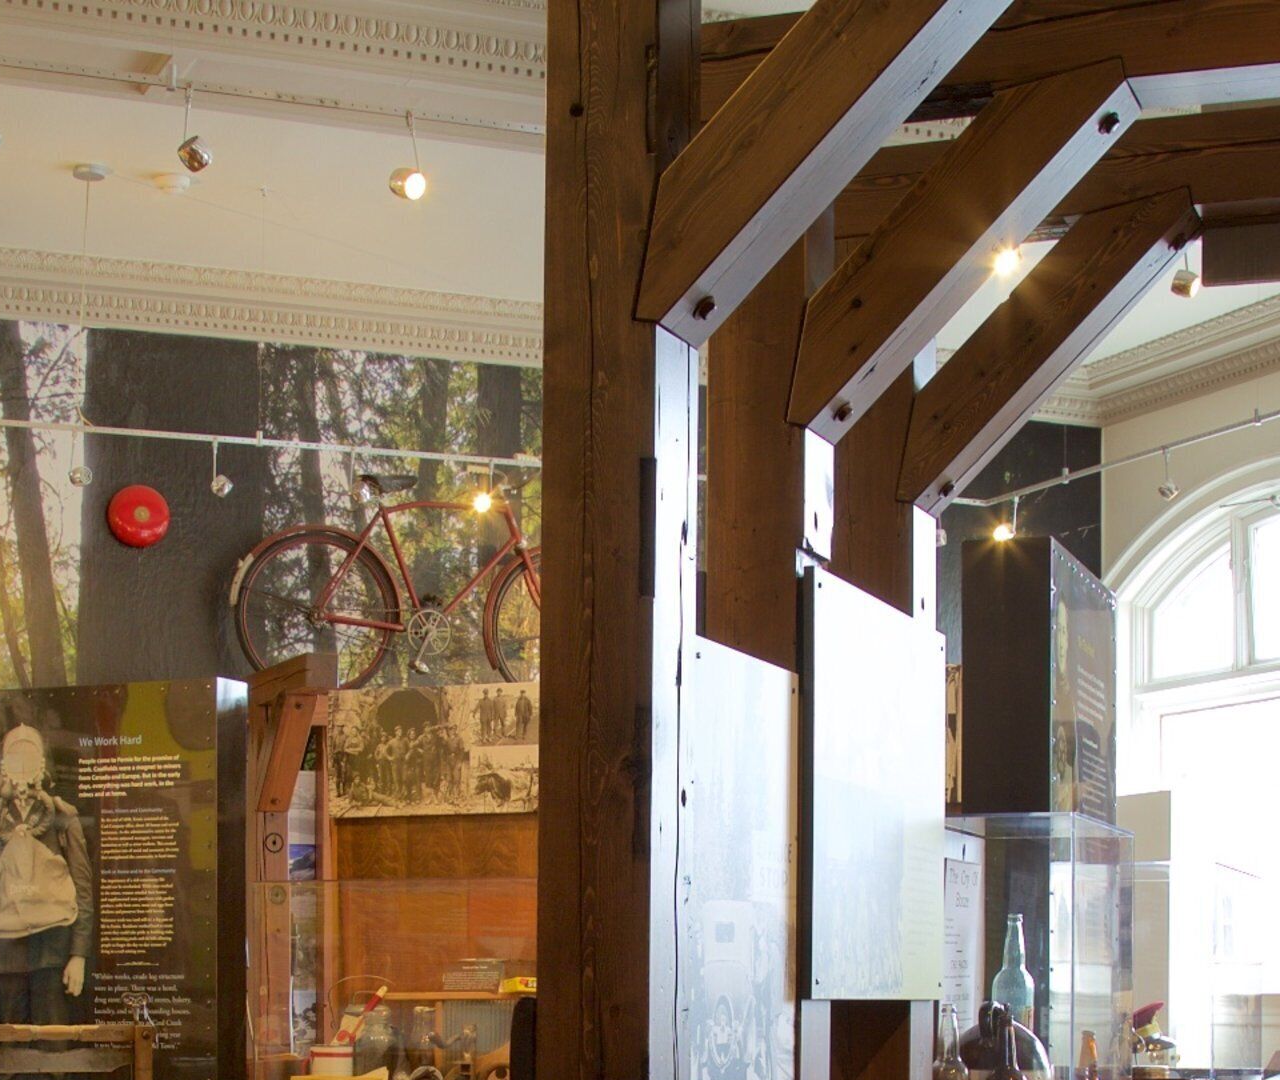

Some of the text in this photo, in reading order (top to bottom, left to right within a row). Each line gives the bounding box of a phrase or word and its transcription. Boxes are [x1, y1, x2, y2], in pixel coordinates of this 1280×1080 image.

[79, 734, 142, 747] We Work Hard
